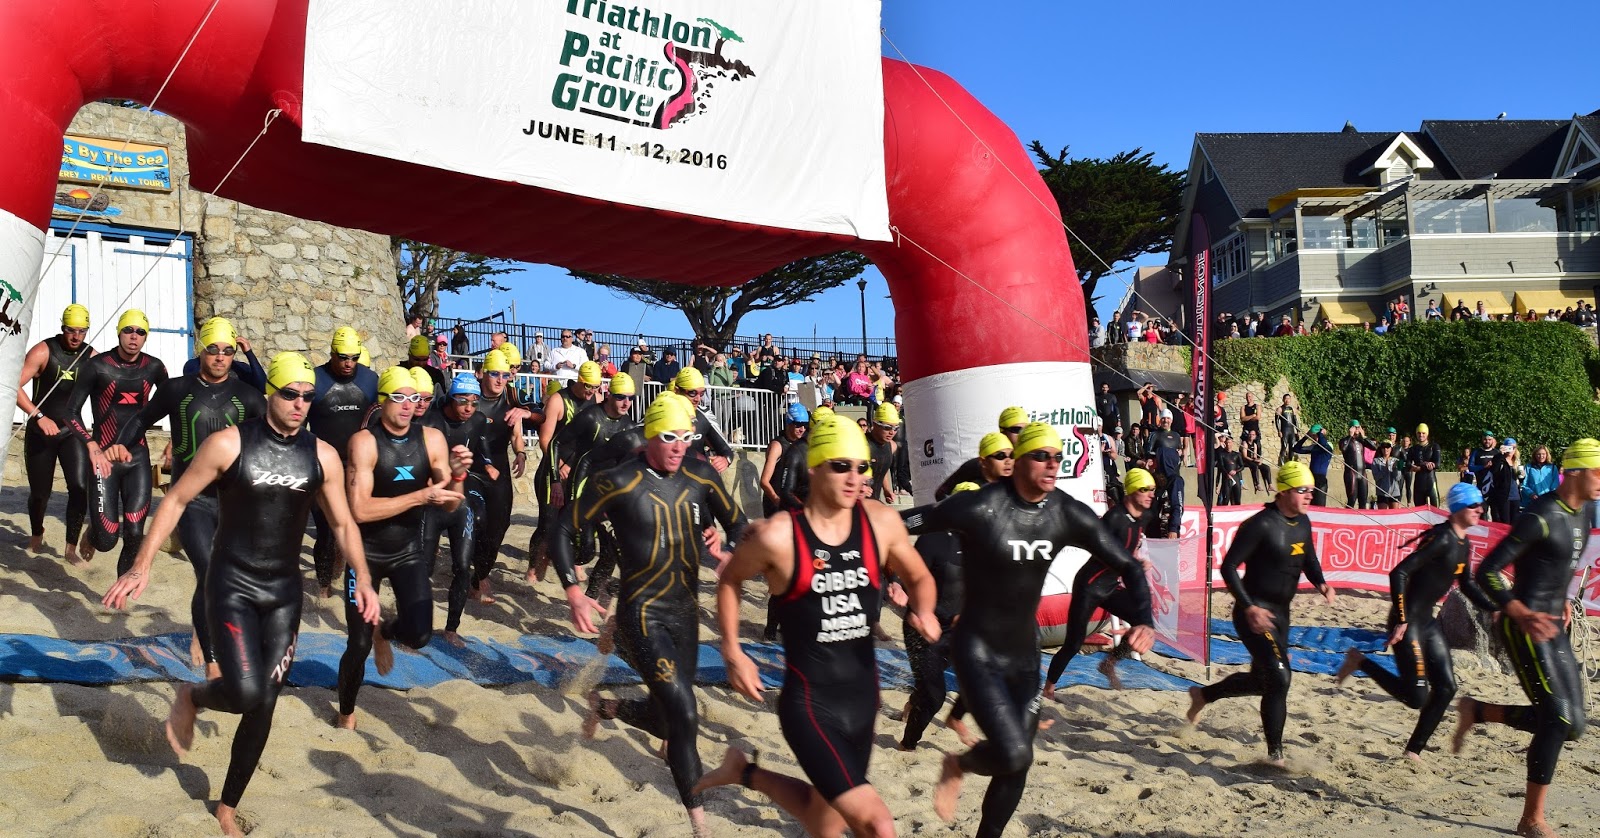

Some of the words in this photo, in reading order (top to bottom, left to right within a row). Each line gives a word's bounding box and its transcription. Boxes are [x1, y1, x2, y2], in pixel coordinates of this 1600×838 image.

[598, 31, 622, 50] at
[559, 29, 676, 91] Pacific
[551, 72, 654, 117] Grove
[78, 144, 98, 162] By
[103, 150, 132, 166] The
[136, 154, 164, 166] Sea
[522, 119, 585, 145] JUNE
[594, 132, 617, 151] 11
[679, 148, 728, 170] 2016
[138, 178, 165, 188] TOURS
[1007, 539, 1054, 561] TYR
[810, 566, 870, 594] GIBBS
[821, 592, 863, 616] USA
[816, 625, 871, 643] RACING
